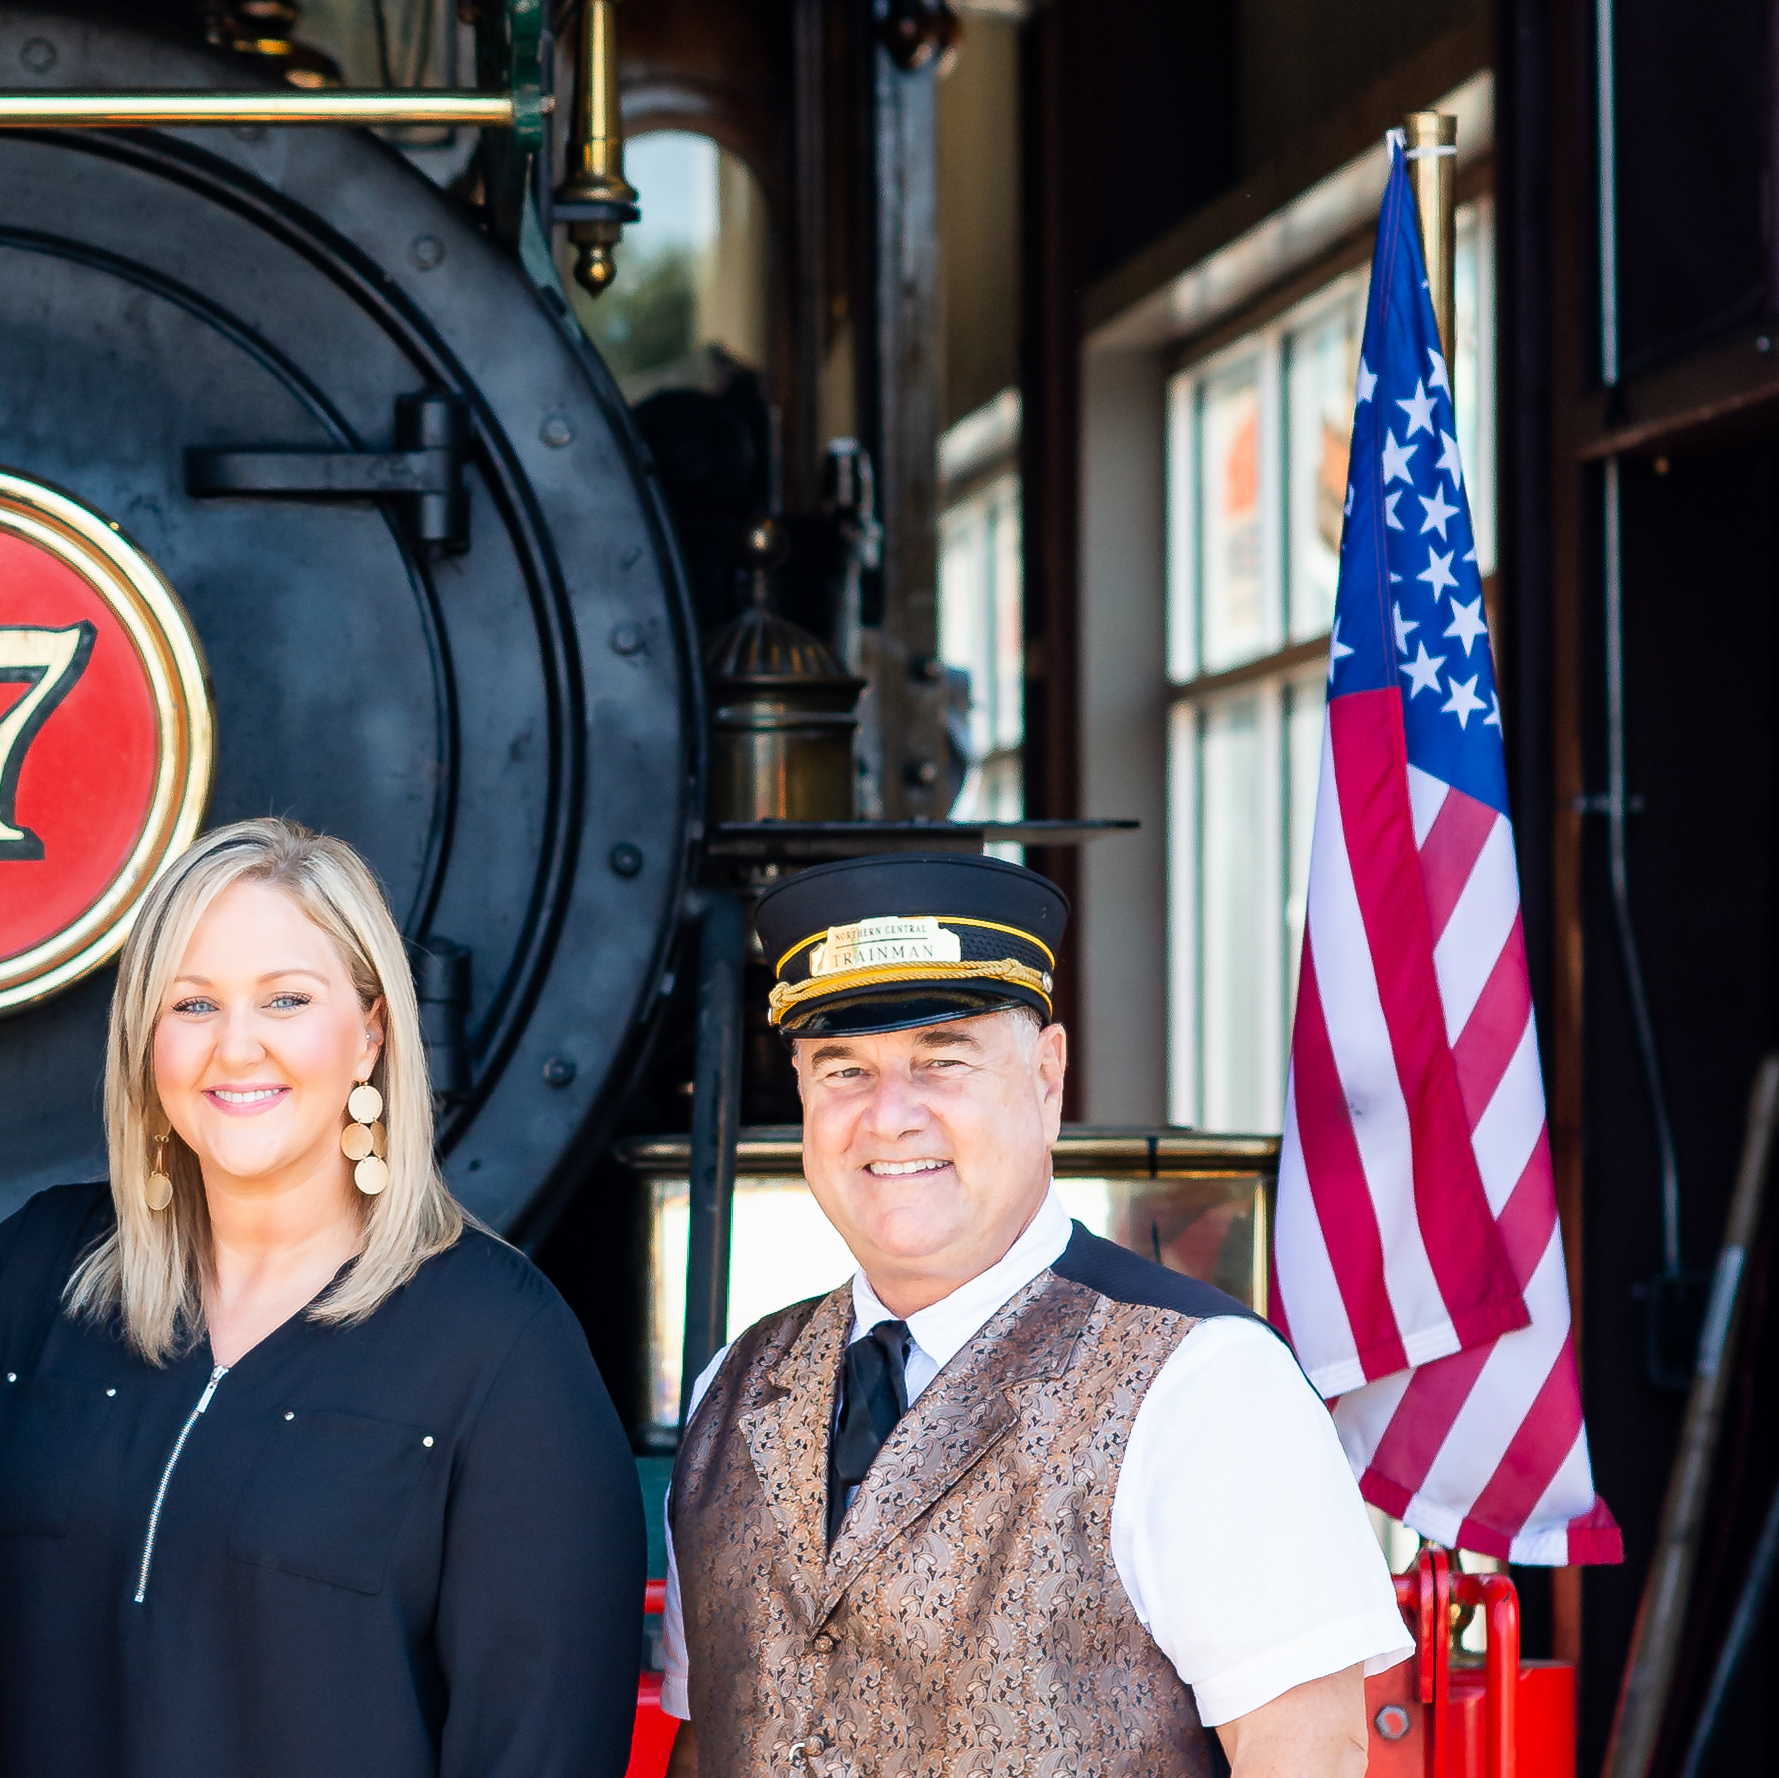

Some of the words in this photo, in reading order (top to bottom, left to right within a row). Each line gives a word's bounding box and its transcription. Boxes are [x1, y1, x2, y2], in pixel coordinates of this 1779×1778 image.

[834, 925, 881, 942] NORTHERN
[885, 924, 927, 934] CENTRAL
[832, 945, 934, 968] TRAINMAN
